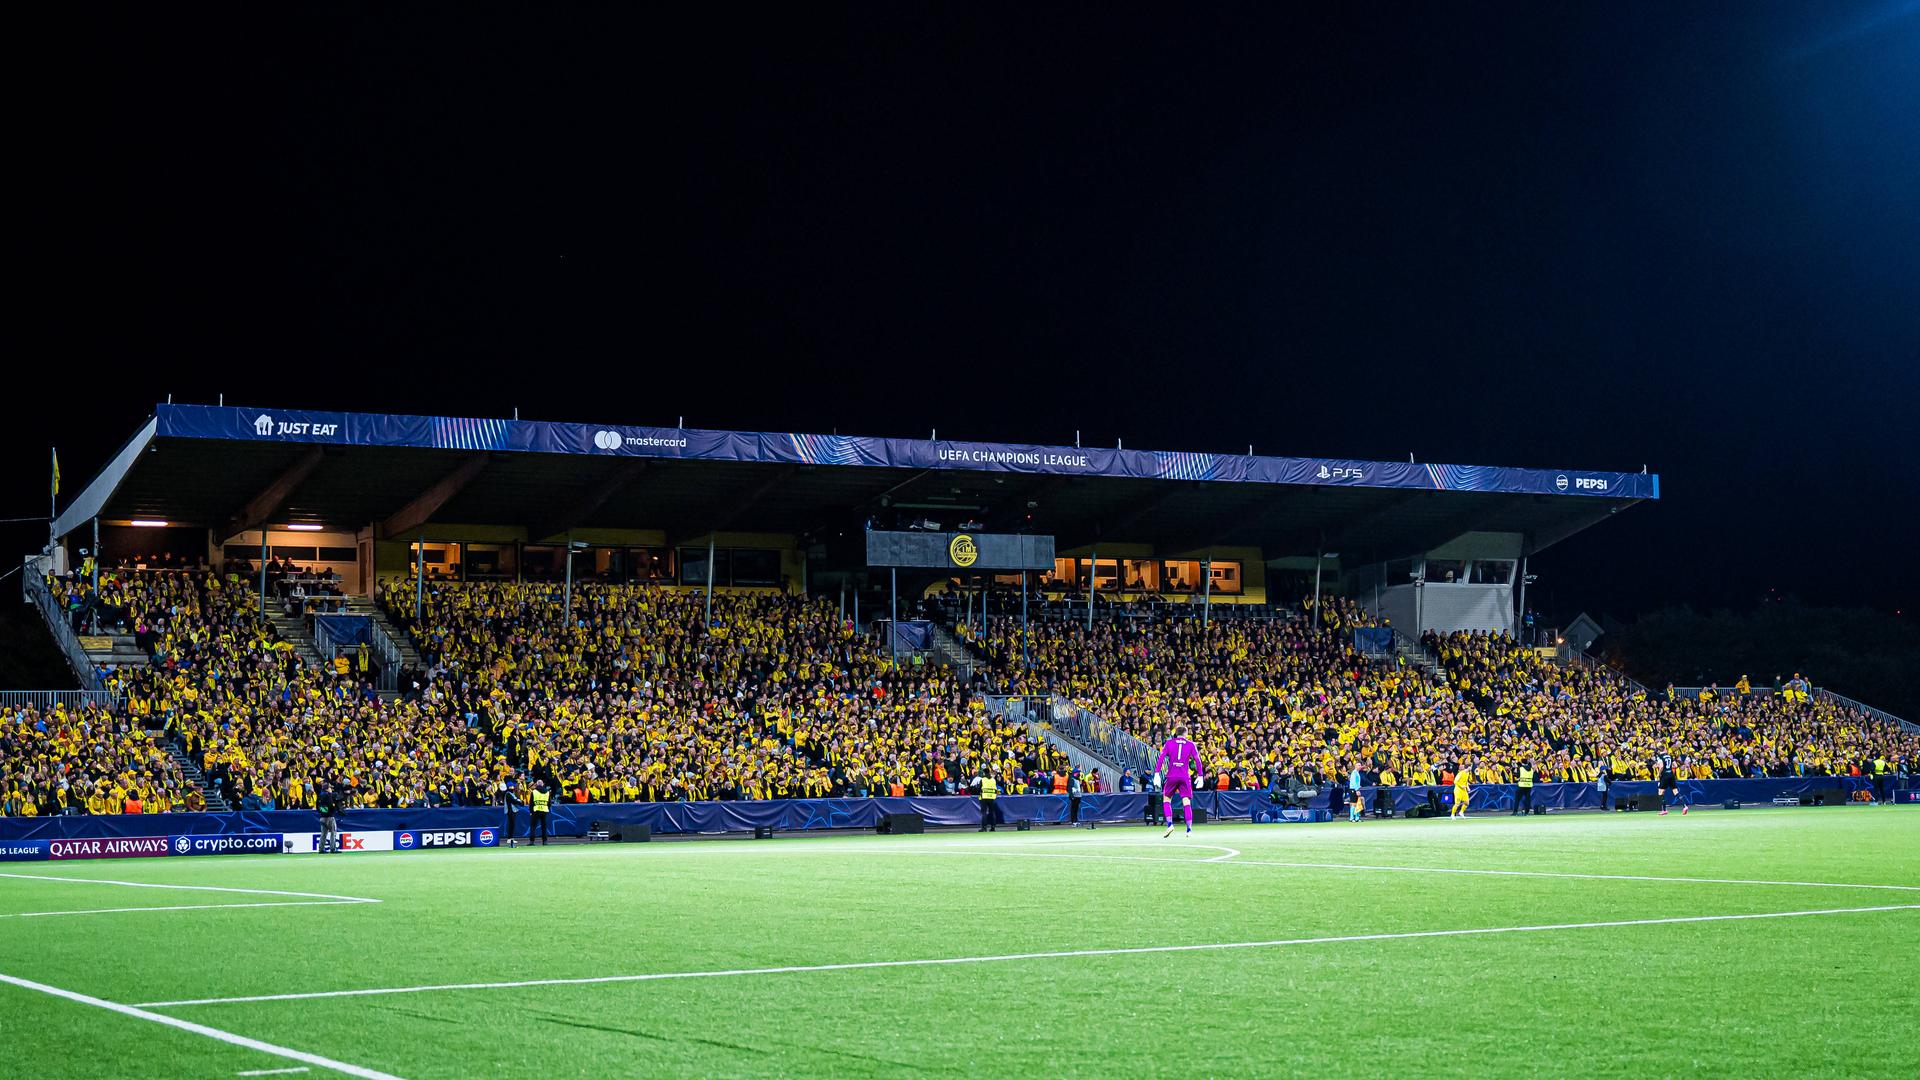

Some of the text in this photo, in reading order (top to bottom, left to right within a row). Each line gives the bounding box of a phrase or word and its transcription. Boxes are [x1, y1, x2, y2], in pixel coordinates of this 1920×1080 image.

[277, 422, 338, 436] JUST EAT
[626, 437, 686, 447] mastercard
[939, 450, 1086, 466] UEFA CHAMPIONS LEAGUE
[1333, 468, 1363, 478] PS5
[1575, 478, 1608, 490] PEPSI
[1177, 743, 1183, 760] 1
[195, 837, 277, 851] crypto.com
[422, 832, 471, 846] PEPSI
[9, 847, 39, 855] LEAGUE
[50, 839, 168, 857] QATAR AIRWAYS
